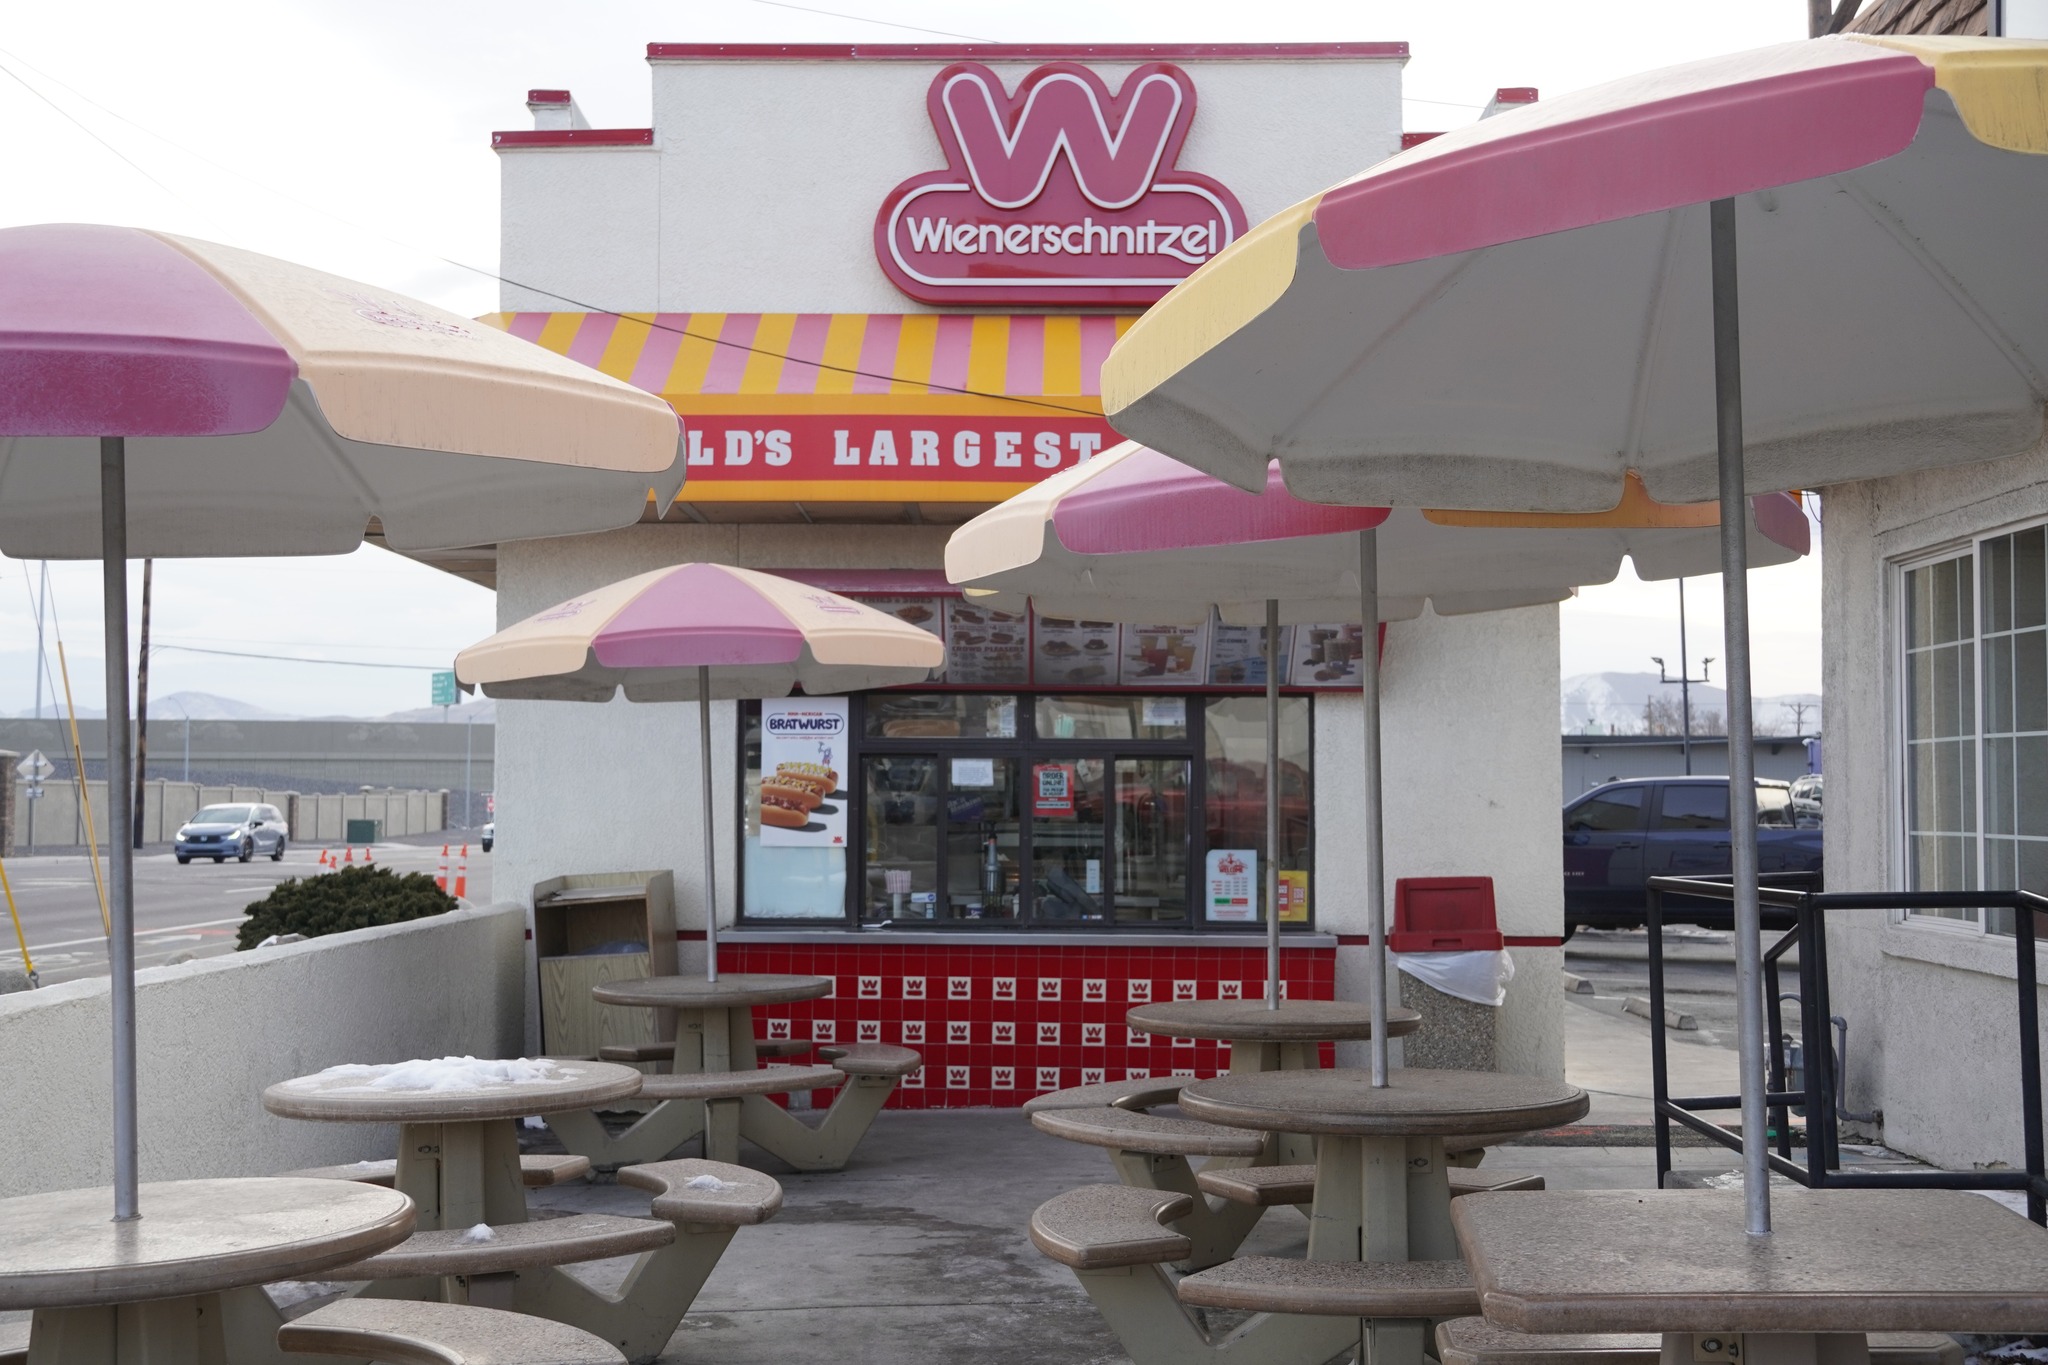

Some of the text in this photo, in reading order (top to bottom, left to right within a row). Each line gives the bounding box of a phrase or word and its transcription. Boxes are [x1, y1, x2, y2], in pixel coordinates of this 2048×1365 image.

[942, 72, 1183, 210] W
[905, 216, 1218, 265] Wienerschnitzel
[834, 430, 1103, 468] LARGEST
[769, 718, 840, 730] BRATWURST
